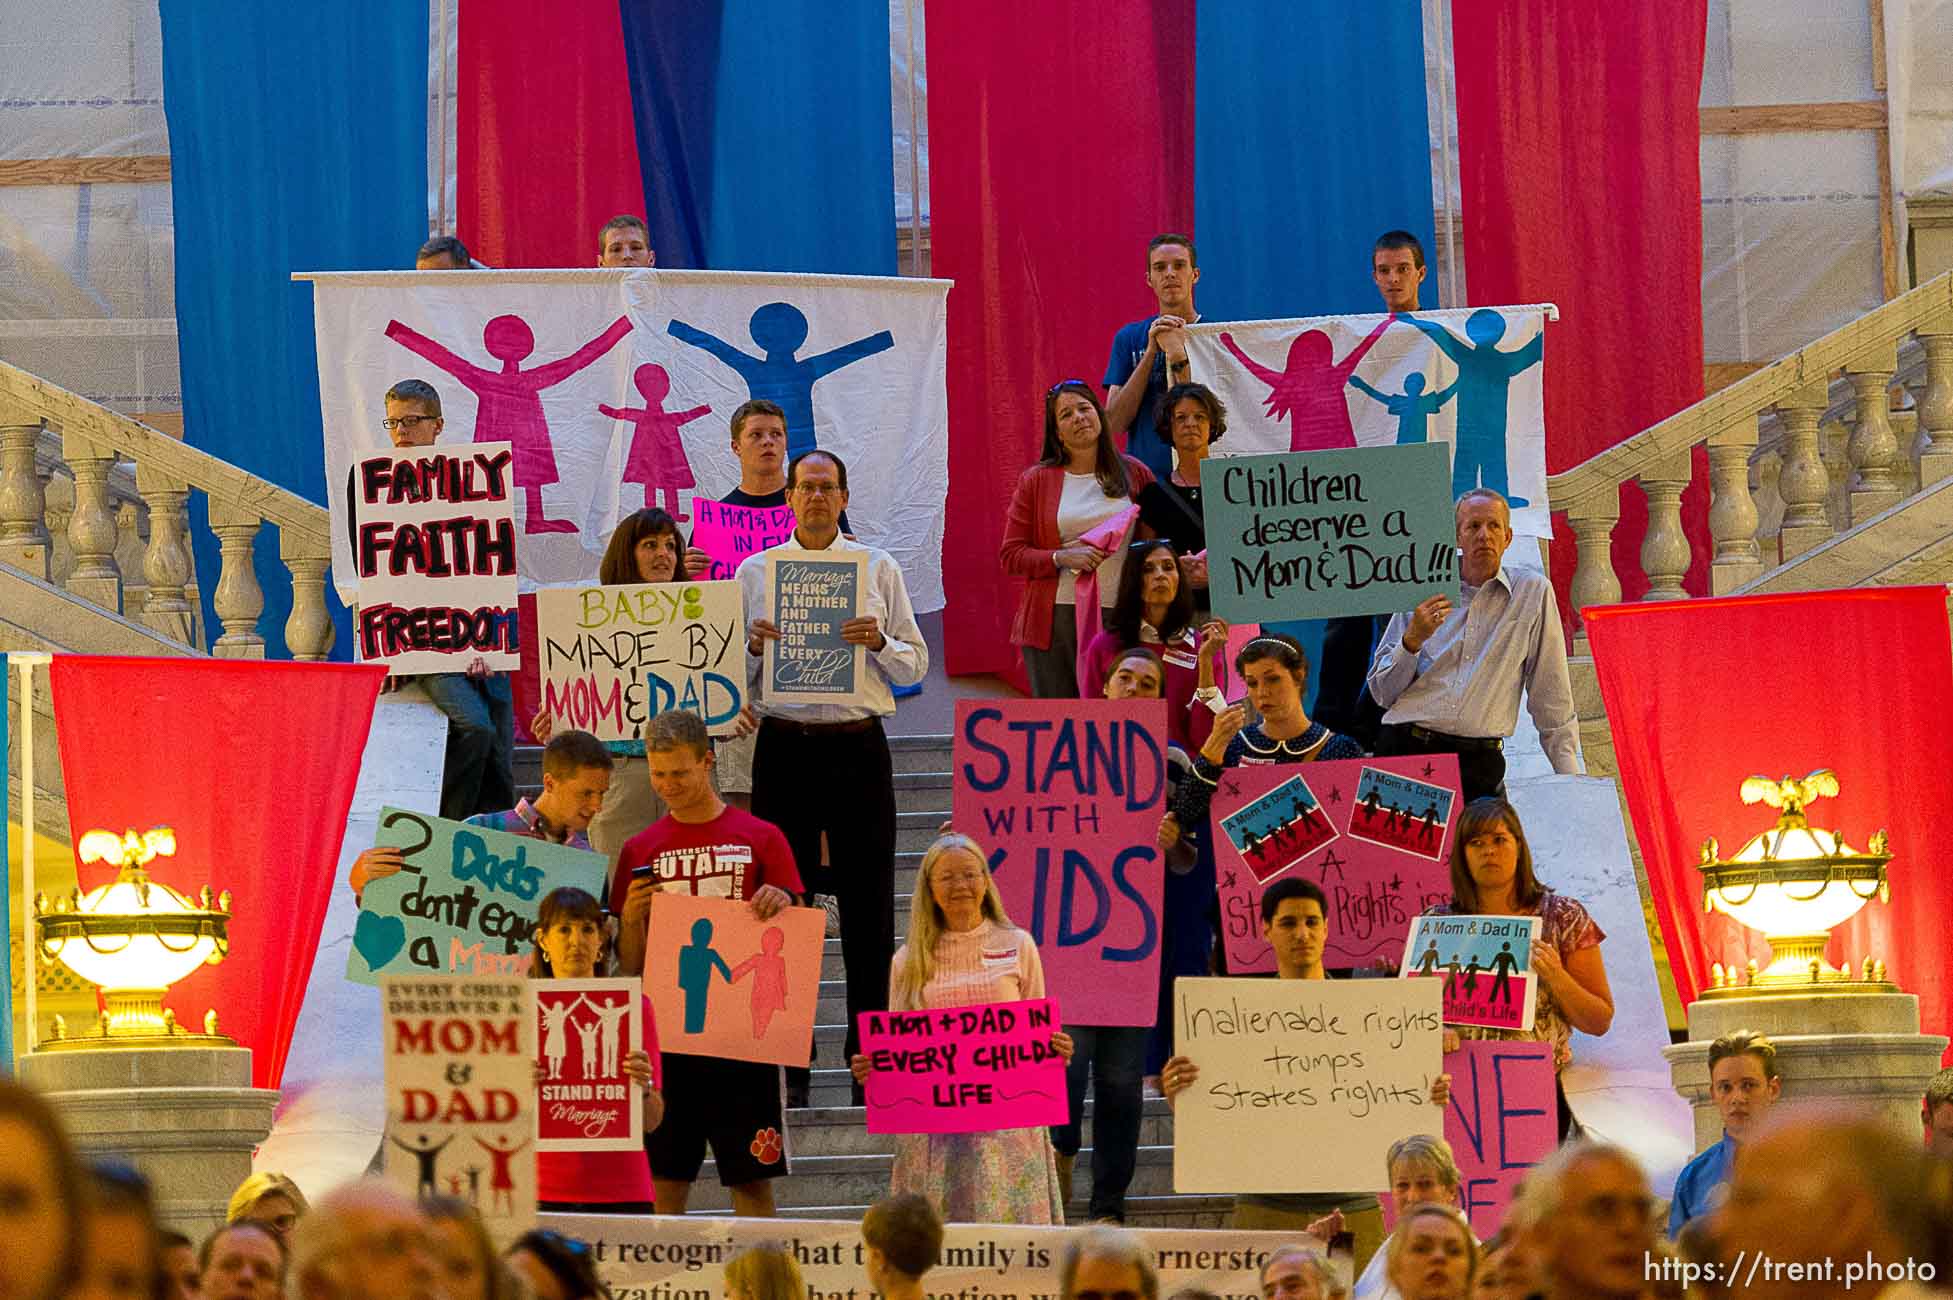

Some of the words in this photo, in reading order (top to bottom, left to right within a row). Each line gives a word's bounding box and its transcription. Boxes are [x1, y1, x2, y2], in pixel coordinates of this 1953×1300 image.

[361, 450, 512, 504] FAMILY
[1224, 463, 1368, 507] Children
[702, 501, 712, 523] A
[771, 508, 795, 529] DA
[1242, 514, 1369, 547] deserve
[1383, 510, 1411, 537] a
[360, 516, 516, 578] FAITH
[734, 535, 752, 552] IN
[781, 563, 854, 597] Marriage
[781, 583, 829, 594] MEANS
[1231, 550, 1317, 599] Mom
[781, 596, 790, 607] A
[792, 596, 848, 608] MOTHER
[781, 608, 808, 620] AND
[360, 602, 520, 660] FREEDOM
[780, 621, 830, 634] FATHER
[780, 634, 806, 646] FOR
[546, 631, 669, 672] MADE
[677, 619, 735, 670] BY
[780, 647, 823, 660] EVERY
[776, 648, 852, 684] Child
[545, 672, 623, 734] MOM
[647, 672, 741, 726] DAD
[964, 708, 1165, 811] STAND
[1376, 775, 1402, 789] Mom
[1416, 785, 1437, 799] Dad
[984, 803, 1100, 836] WITH
[384, 812, 433, 874] 2
[452, 830, 544, 901] Dads
[660, 852, 733, 878] UTAH
[1320, 849, 1346, 883] A
[988, 845, 1157, 961] IDS
[1334, 881, 1407, 940] Rights
[478, 902, 537, 955] equ
[1421, 922, 1430, 936] A
[1434, 922, 1463, 935] Mom
[1467, 921, 1477, 935] &
[1481, 922, 1510, 936] Dad
[1514, 924, 1528, 938] In
[409, 936, 440, 969] a
[388, 983, 452, 997] EVERY
[462, 983, 521, 997] CHILD
[389, 1001, 499, 1014] DESERVES
[509, 1001, 520, 1014] A
[870, 1015, 883, 1036] A
[939, 1014, 957, 1031] +
[959, 1008, 1015, 1034] DAD
[1029, 1005, 1051, 1028] IN
[1183, 993, 1348, 1040] Inalienable
[1364, 1006, 1439, 1049] rights
[1491, 1005, 1517, 1020] Life
[392, 1020, 520, 1055] MOM
[445, 1063, 472, 1084] &
[871, 1043, 957, 1076] EVERY
[1264, 1045, 1365, 1083] trumps
[401, 1089, 519, 1124] DAD
[543, 1085, 592, 1100] STAND
[596, 1085, 626, 1100] FOR
[933, 1084, 992, 1107] LIFE
[1210, 1082, 1317, 1110] States
[1450, 1050, 1546, 1168] NE
[550, 1102, 618, 1137] Marriage
[618, 1238, 735, 1271] recogni
[790, 1238, 842, 1265] hat
[938, 1241, 1016, 1274] mily
[1026, 1241, 1050, 1268] is
[1158, 1246, 1271, 1270] rnersto
